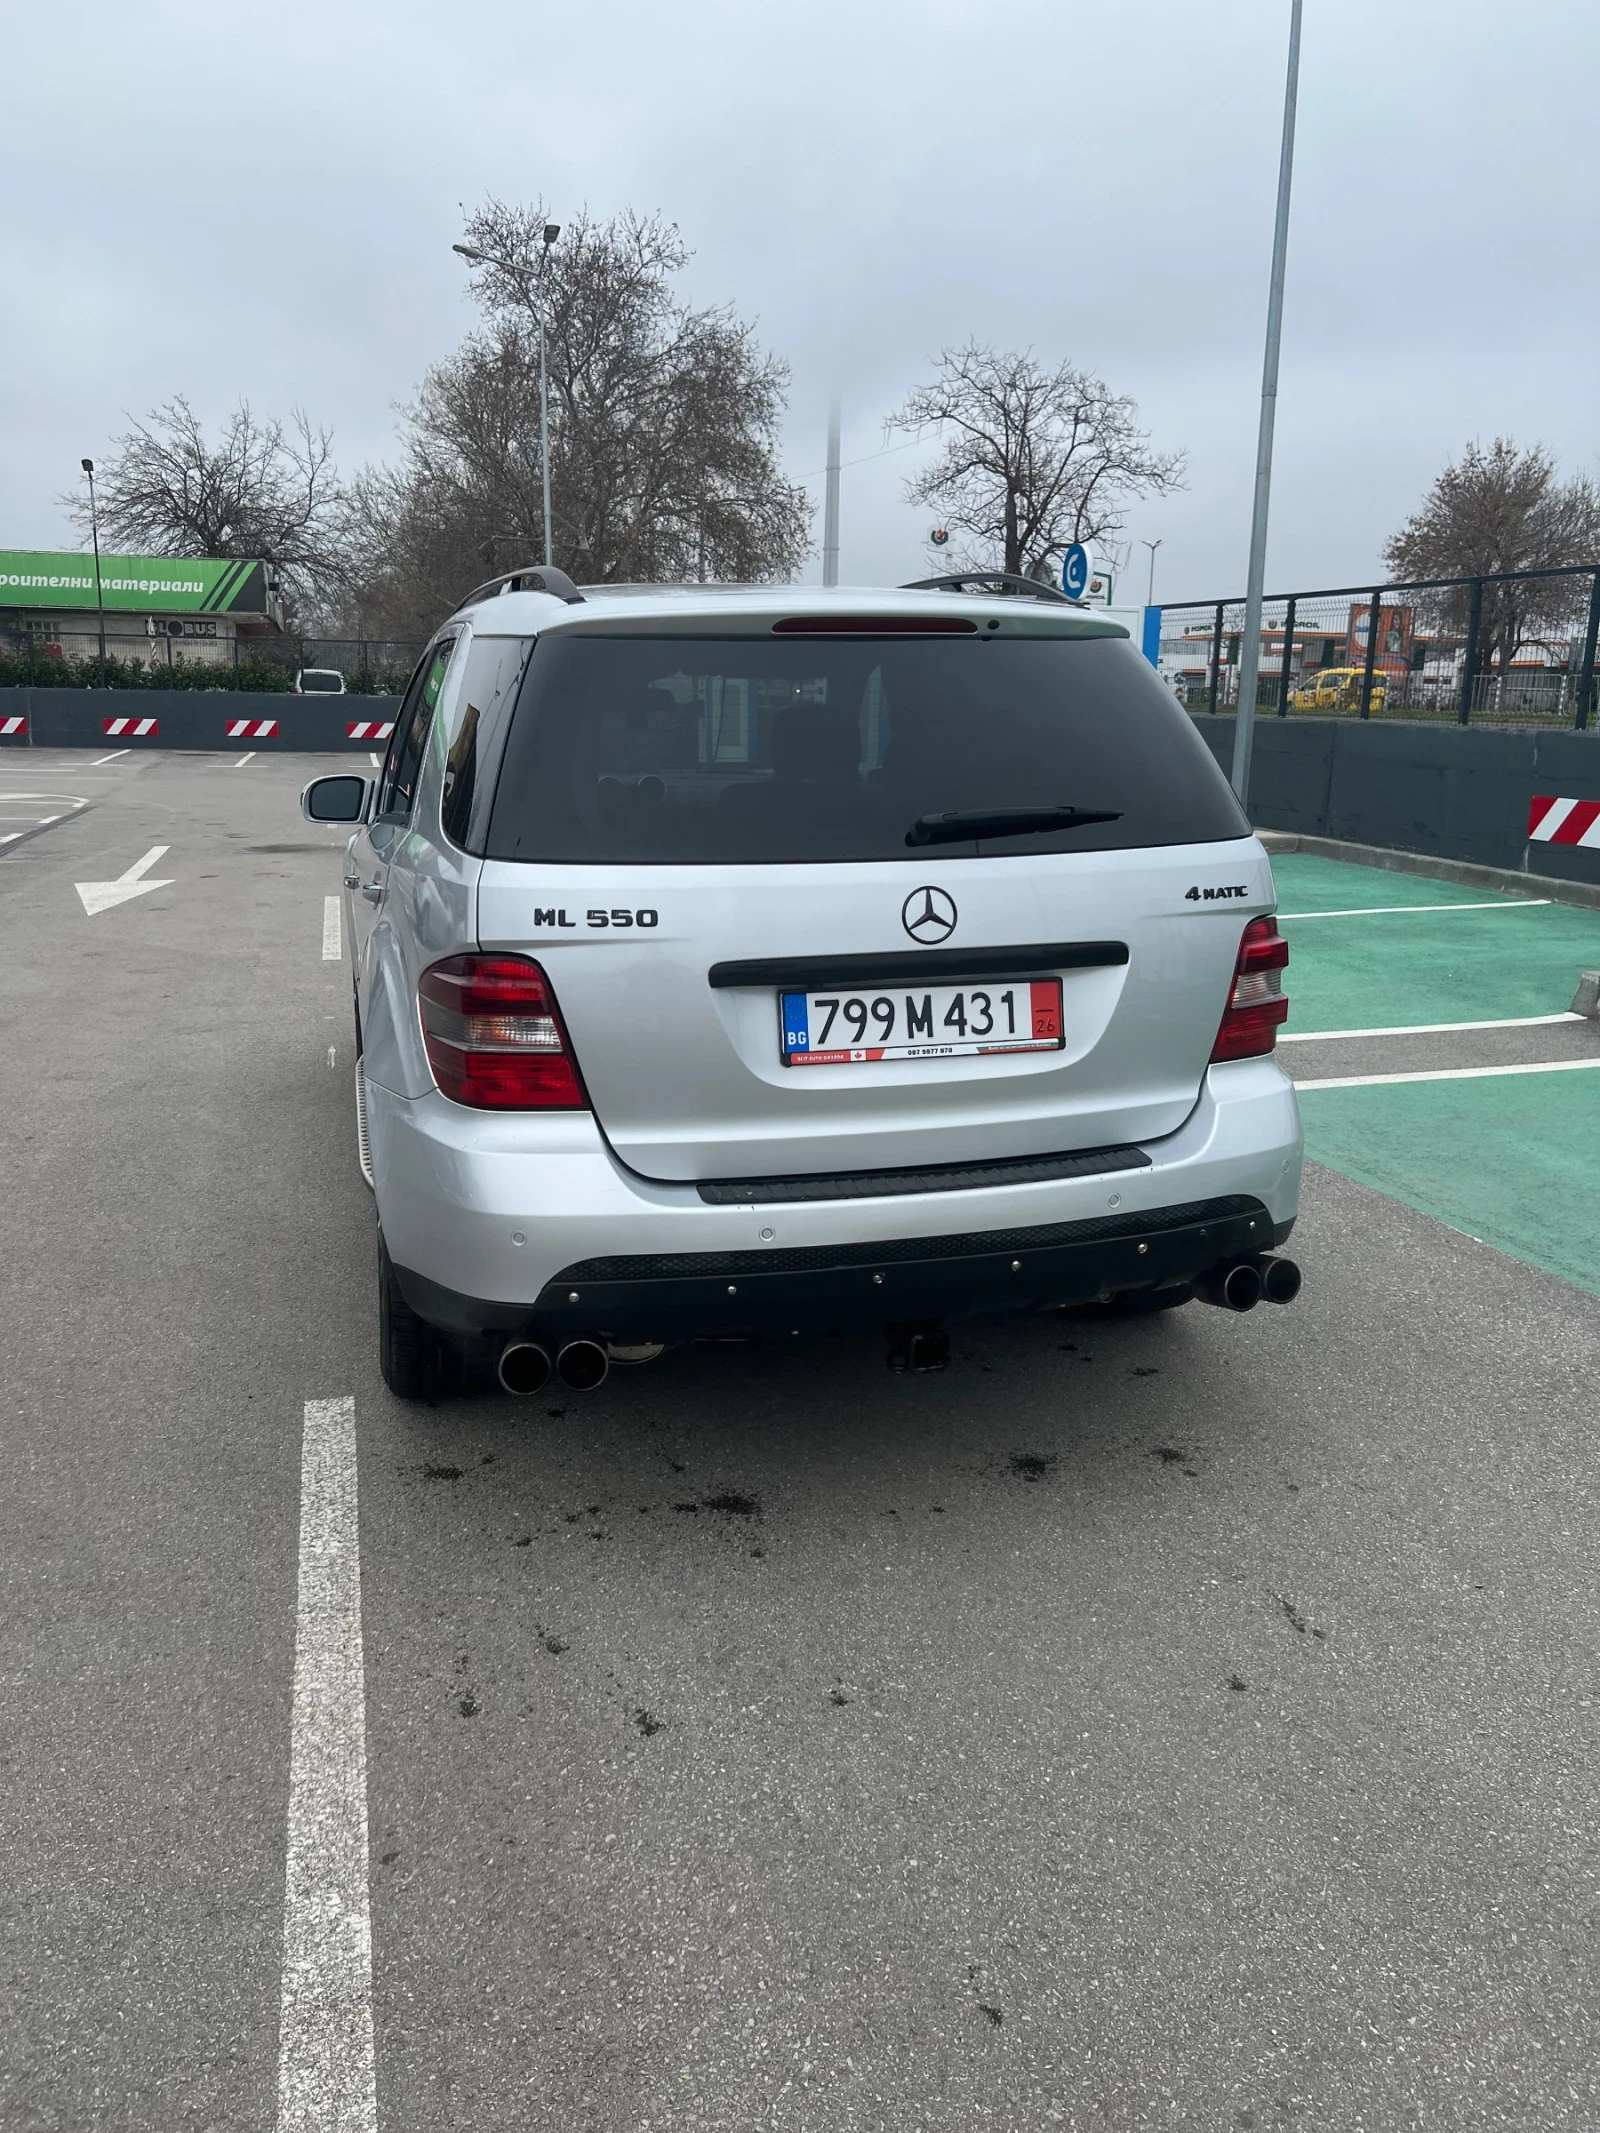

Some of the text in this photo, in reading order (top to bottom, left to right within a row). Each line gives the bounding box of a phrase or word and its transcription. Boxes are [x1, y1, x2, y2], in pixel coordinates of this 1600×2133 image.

[97, 578, 203, 594] материали
[534, 908, 659, 928] ML 550
[814, 990, 1016, 1045] 799 M 431
[1036, 1018, 1055, 1033] 26
[788, 1031, 806, 1045] BG
